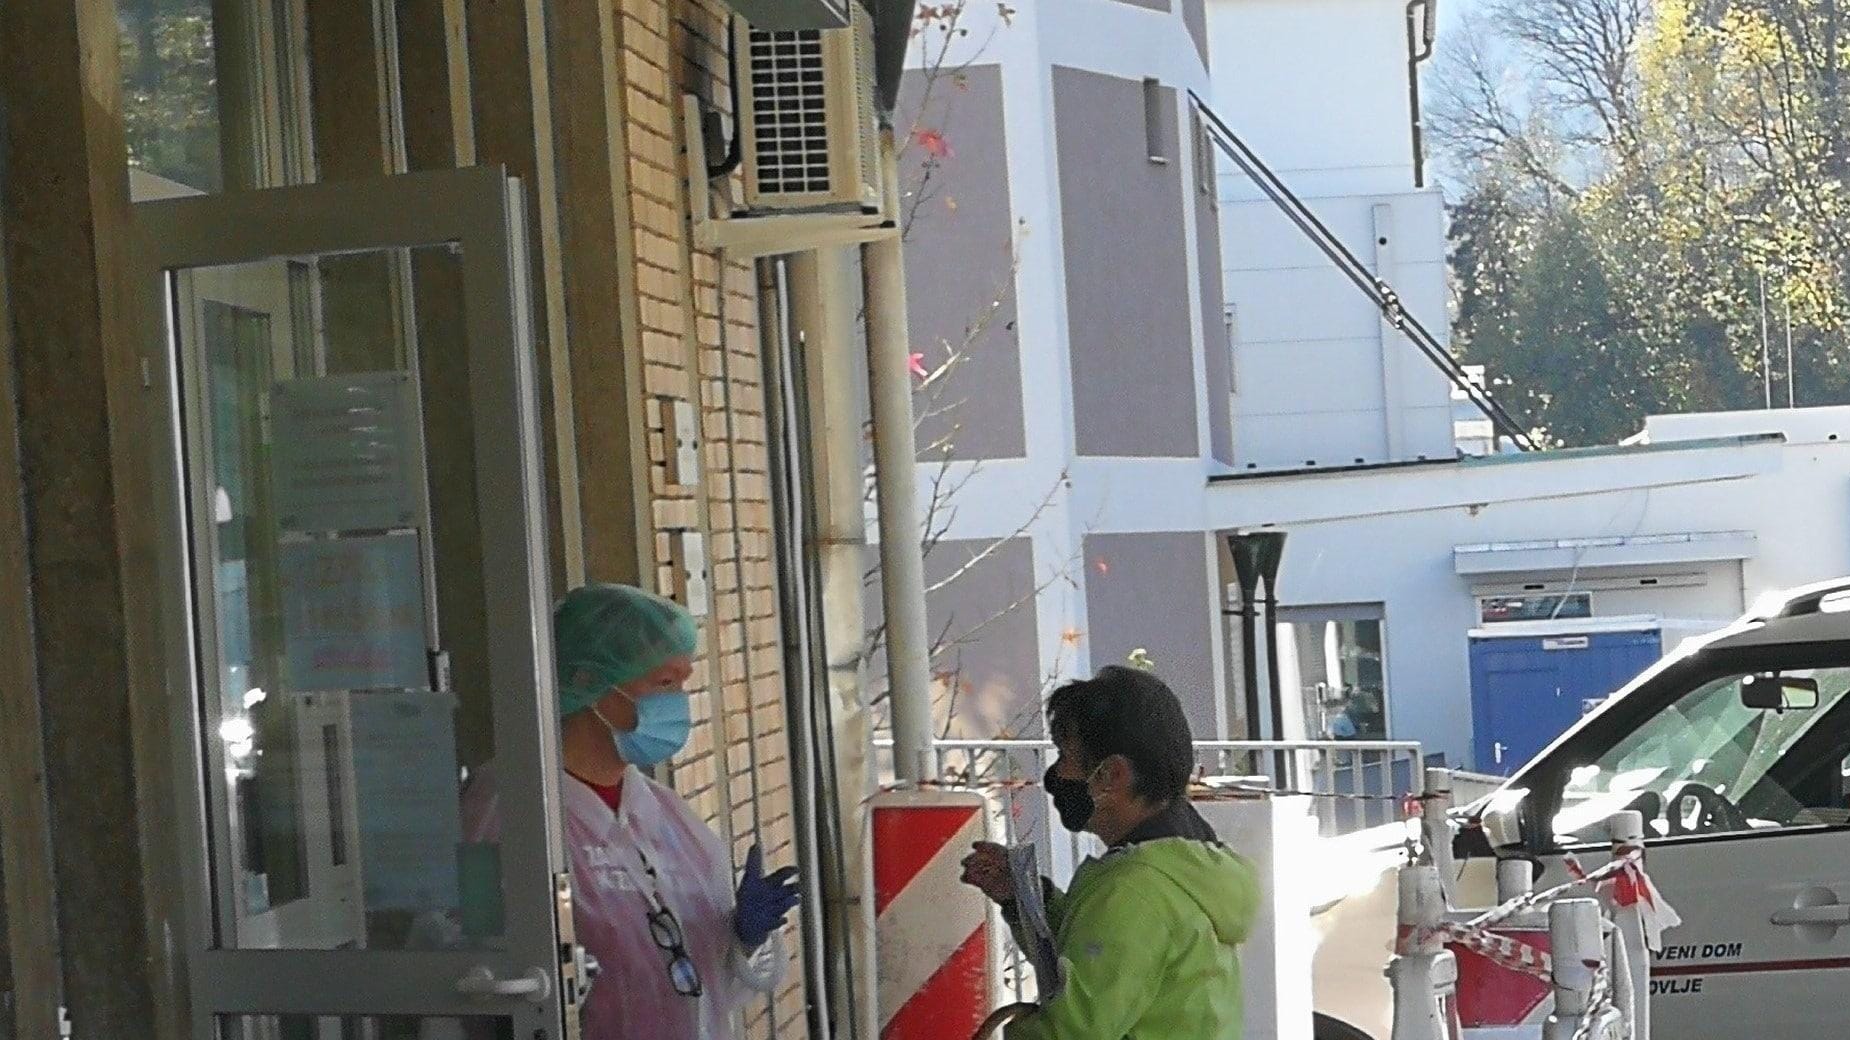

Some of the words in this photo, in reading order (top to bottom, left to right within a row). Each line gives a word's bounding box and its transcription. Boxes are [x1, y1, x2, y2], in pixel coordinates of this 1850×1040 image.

[1656, 946, 1697, 960] VENI
[1701, 943, 1742, 958] DOM
[1650, 978, 1703, 995] OVLJE
